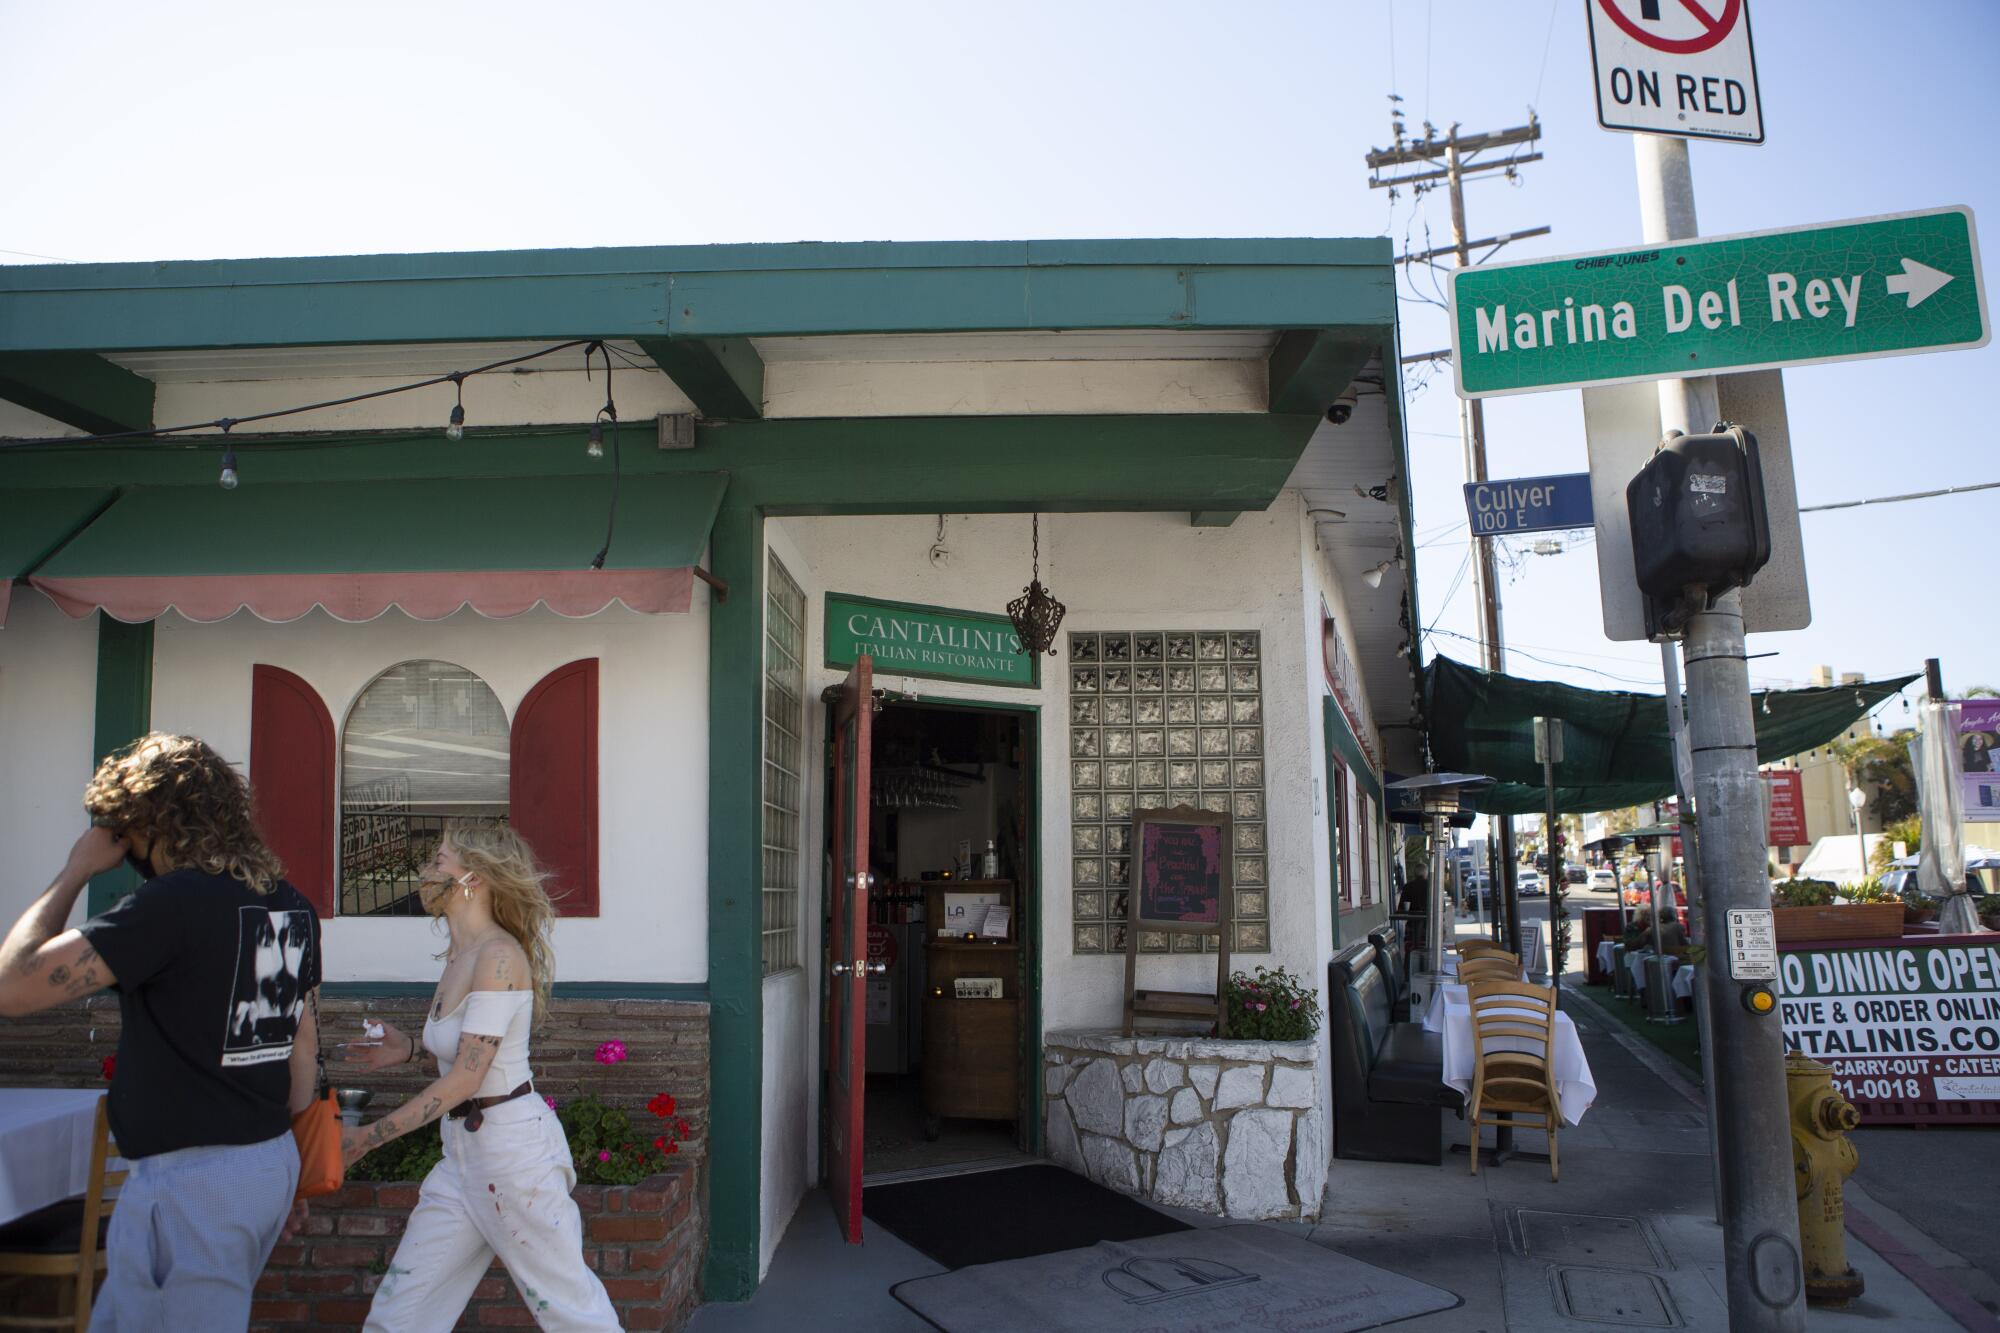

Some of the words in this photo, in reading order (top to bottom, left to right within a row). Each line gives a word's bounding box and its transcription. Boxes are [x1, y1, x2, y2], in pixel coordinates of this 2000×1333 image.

[1611, 67, 1661, 108] ON
[1676, 74, 1747, 116] RED
[1575, 256, 1614, 270] CHIEF
[1476, 297, 1637, 355] Marina
[1662, 278, 1740, 334] Del
[1767, 272, 1862, 328] Rey
[1475, 484, 1555, 512] Culver
[1478, 511, 1507, 531] 100
[1516, 509, 1528, 527] E
[848, 614, 1022, 655] CANTALINI'S
[855, 642, 917, 662] ITALIAN
[922, 651, 1015, 672] RISTORANTE
[947, 905, 965, 917] LA
[1811, 949, 1921, 994] DINING
[1833, 1001, 1848, 1024] &
[1854, 999, 1931, 1023] ORDER
[1831, 1059, 1929, 1076] CARRY-OUT
